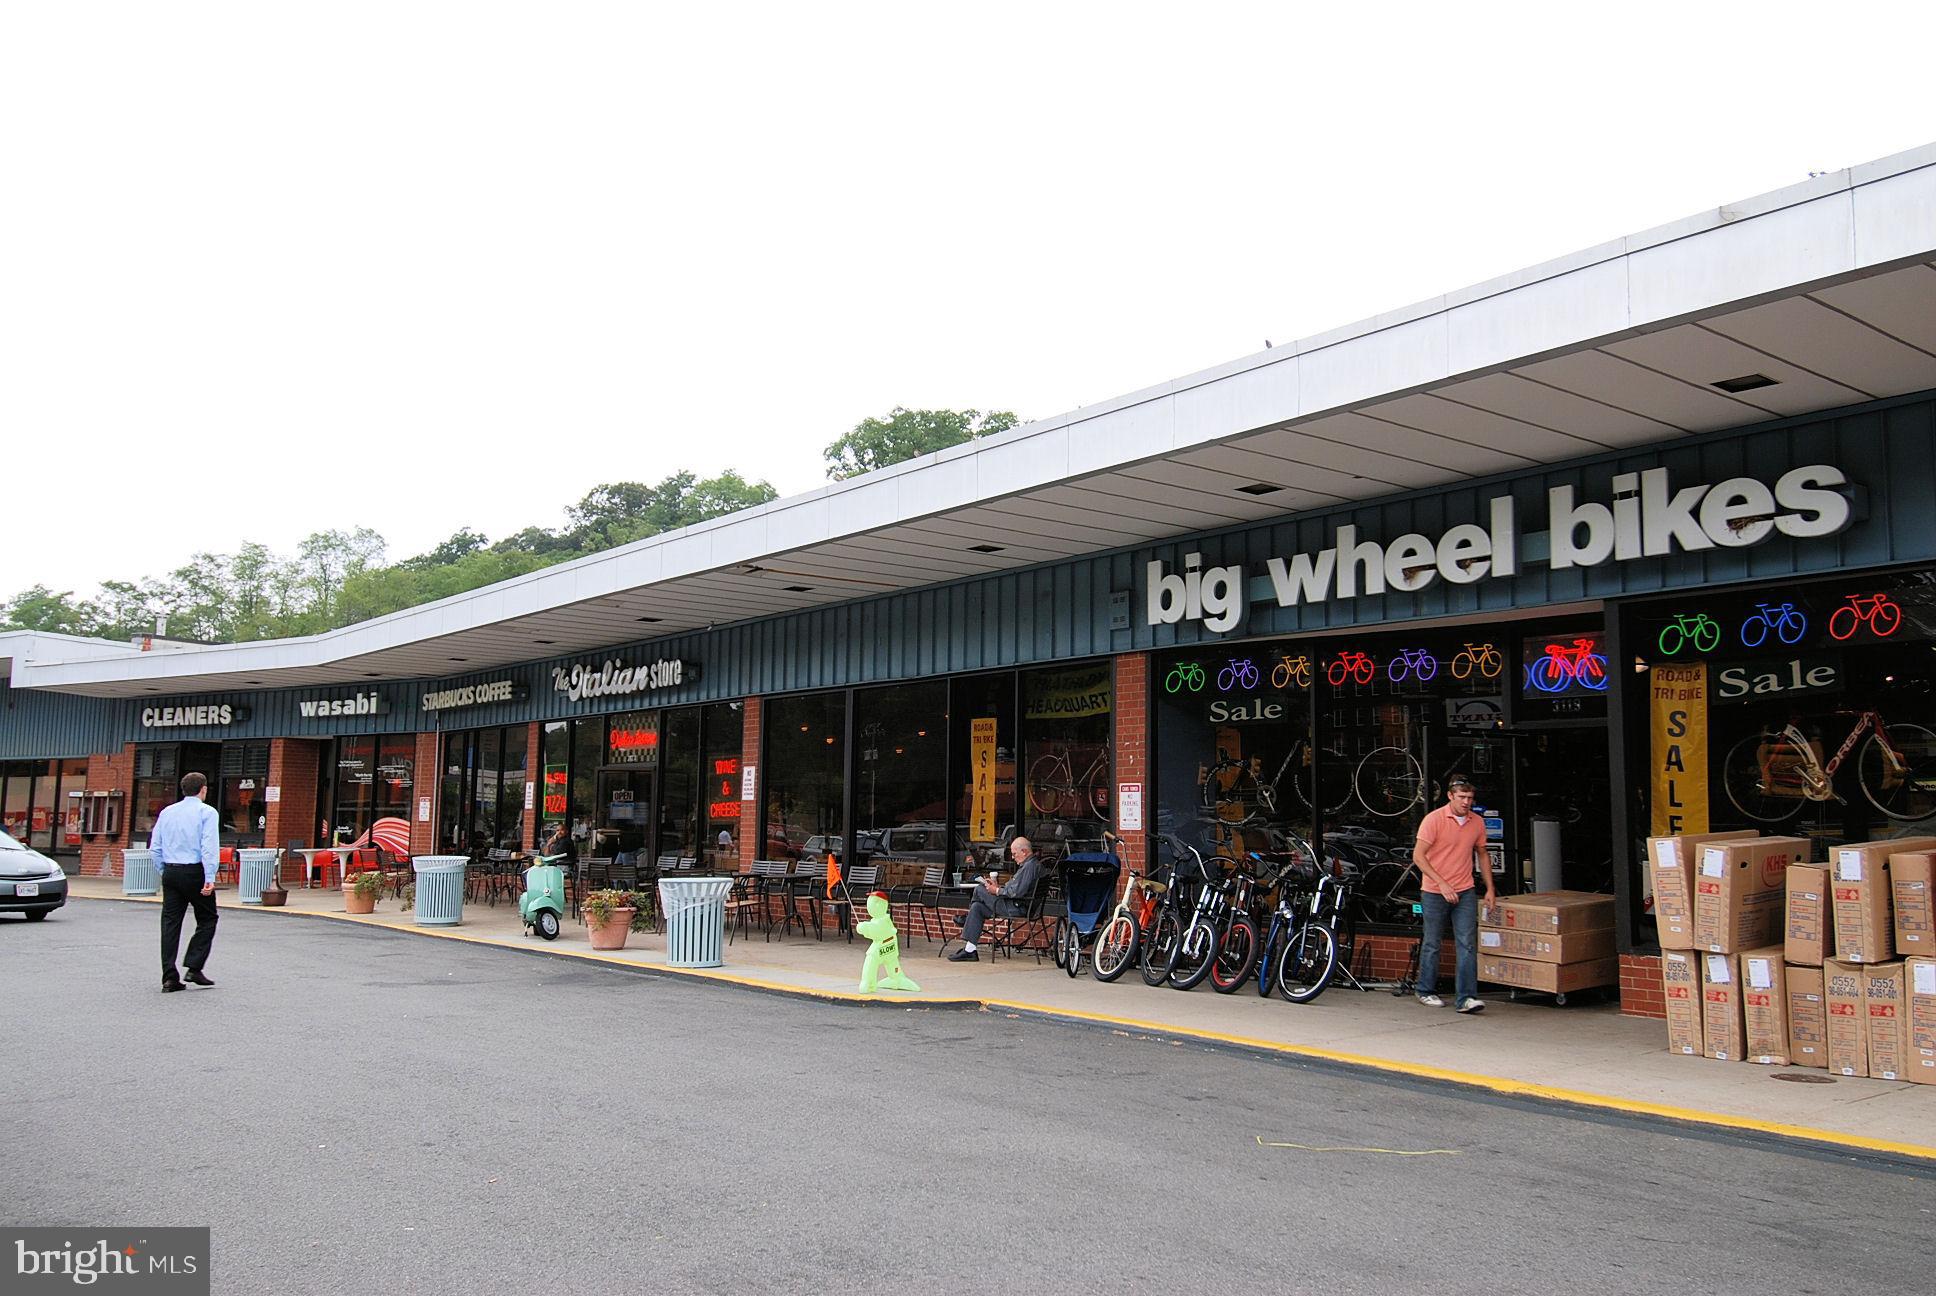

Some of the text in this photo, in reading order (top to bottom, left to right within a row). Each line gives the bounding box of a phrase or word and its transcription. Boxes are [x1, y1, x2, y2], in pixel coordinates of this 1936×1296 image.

[1147, 464, 1850, 633] big wheel bikes
[552, 658, 682, 702] The Italian store
[1657, 668, 1702, 682] ROAD&
[1719, 660, 1835, 697] Sale
[422, 680, 513, 712] STARBUCKS COFFEE
[1027, 690, 1110, 713] HEADQUART
[1654, 687, 1702, 700] TRI BIKE
[300, 692, 377, 717] wasabi
[1209, 698, 1283, 722] Sale
[141, 704, 232, 728] CLEANERS
[715, 759, 736, 775] WINE
[614, 792, 632, 801] OPEN
[722, 780, 731, 796] &
[978, 750, 988, 837] SALE
[710, 802, 741, 818] CHEESE
[1766, 854, 1787, 872] KHS
[1667, 962, 1688, 972] 0552
[1832, 976, 1856, 987] 0552
[1870, 977, 1895, 989] 0552
